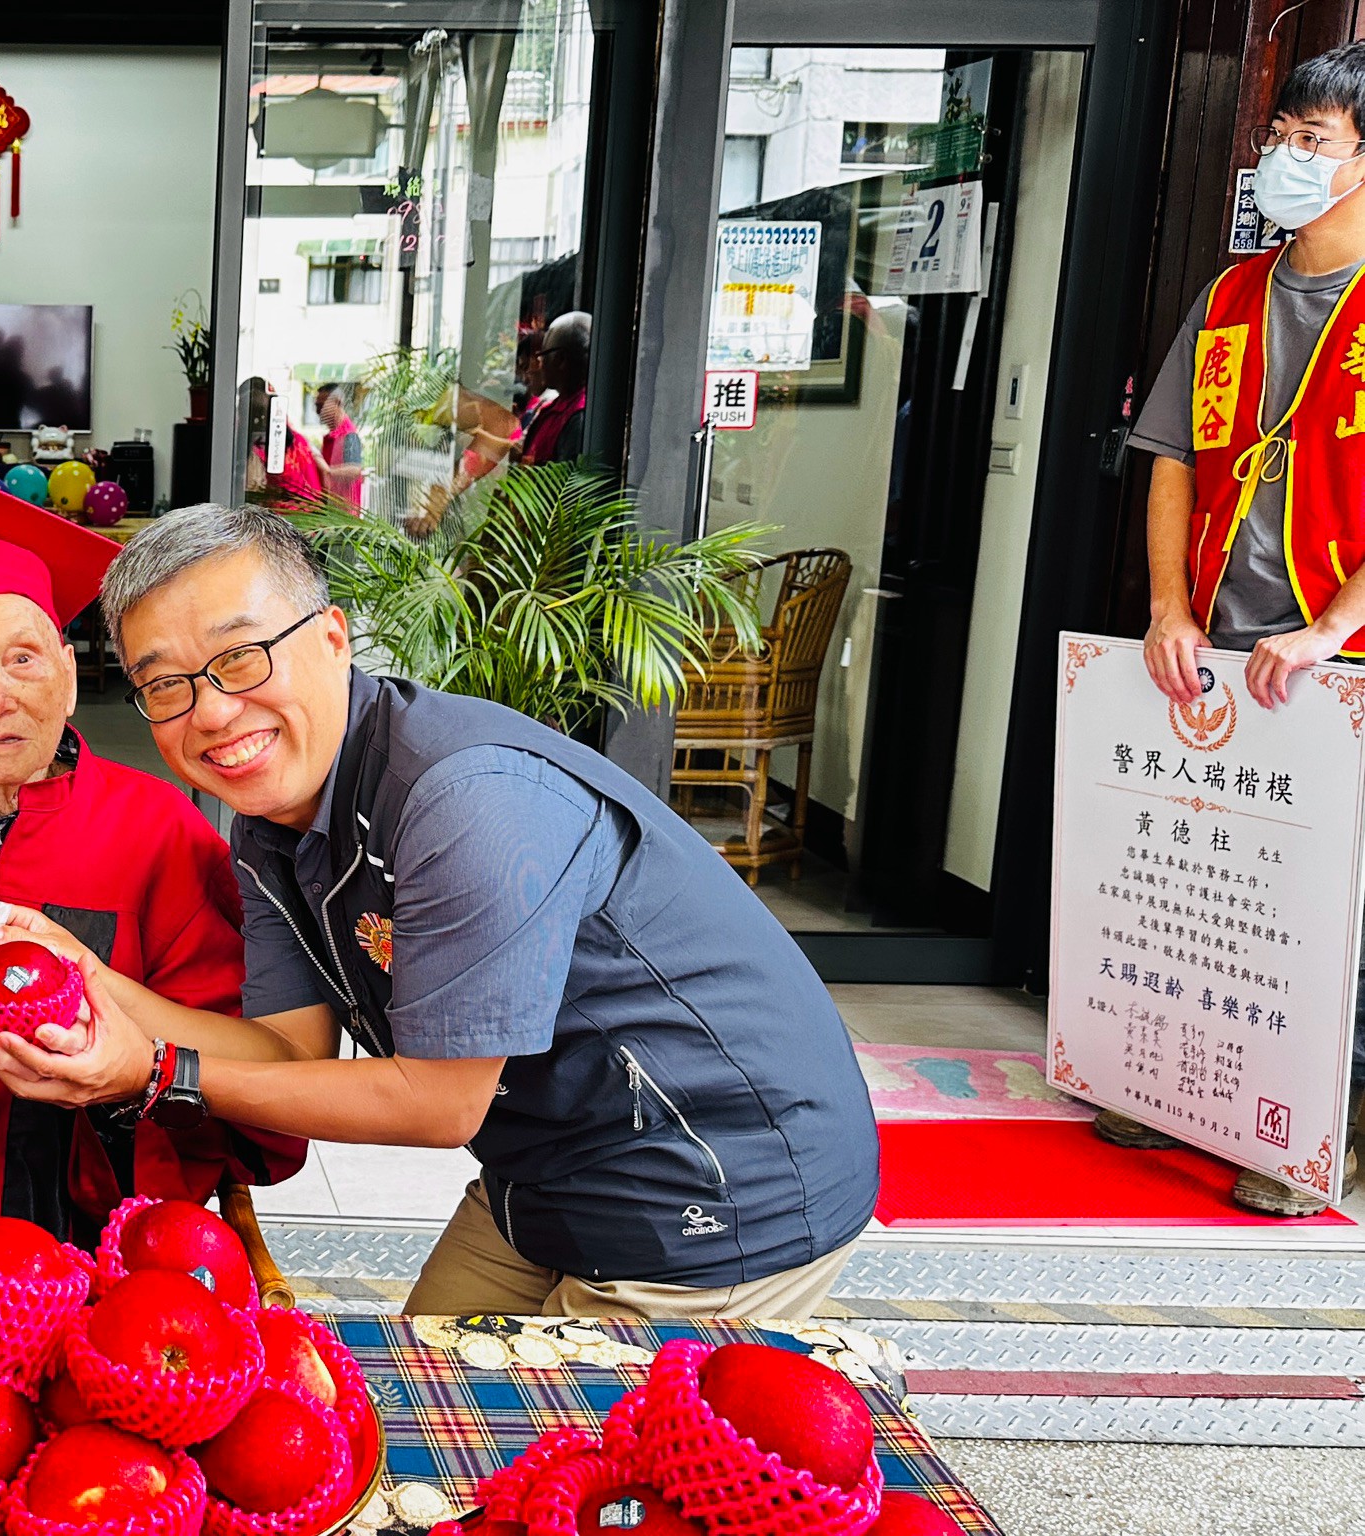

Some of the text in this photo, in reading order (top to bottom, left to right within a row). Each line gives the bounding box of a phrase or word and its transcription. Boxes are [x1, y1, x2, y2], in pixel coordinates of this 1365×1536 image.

[919, 199, 945, 258] 2
[1234, 238, 1254, 249] 558
[714, 378, 746, 408] 推
[1198, 335, 1233, 442] 鹿谷
[712, 410, 746, 422] PUSH
[1113, 743, 1293, 806] 警界人瑞楷模
[1257, 846, 1283, 864] 先生
[1098, 957, 1288, 1036] 天賜遐齡 喜樂常伴
